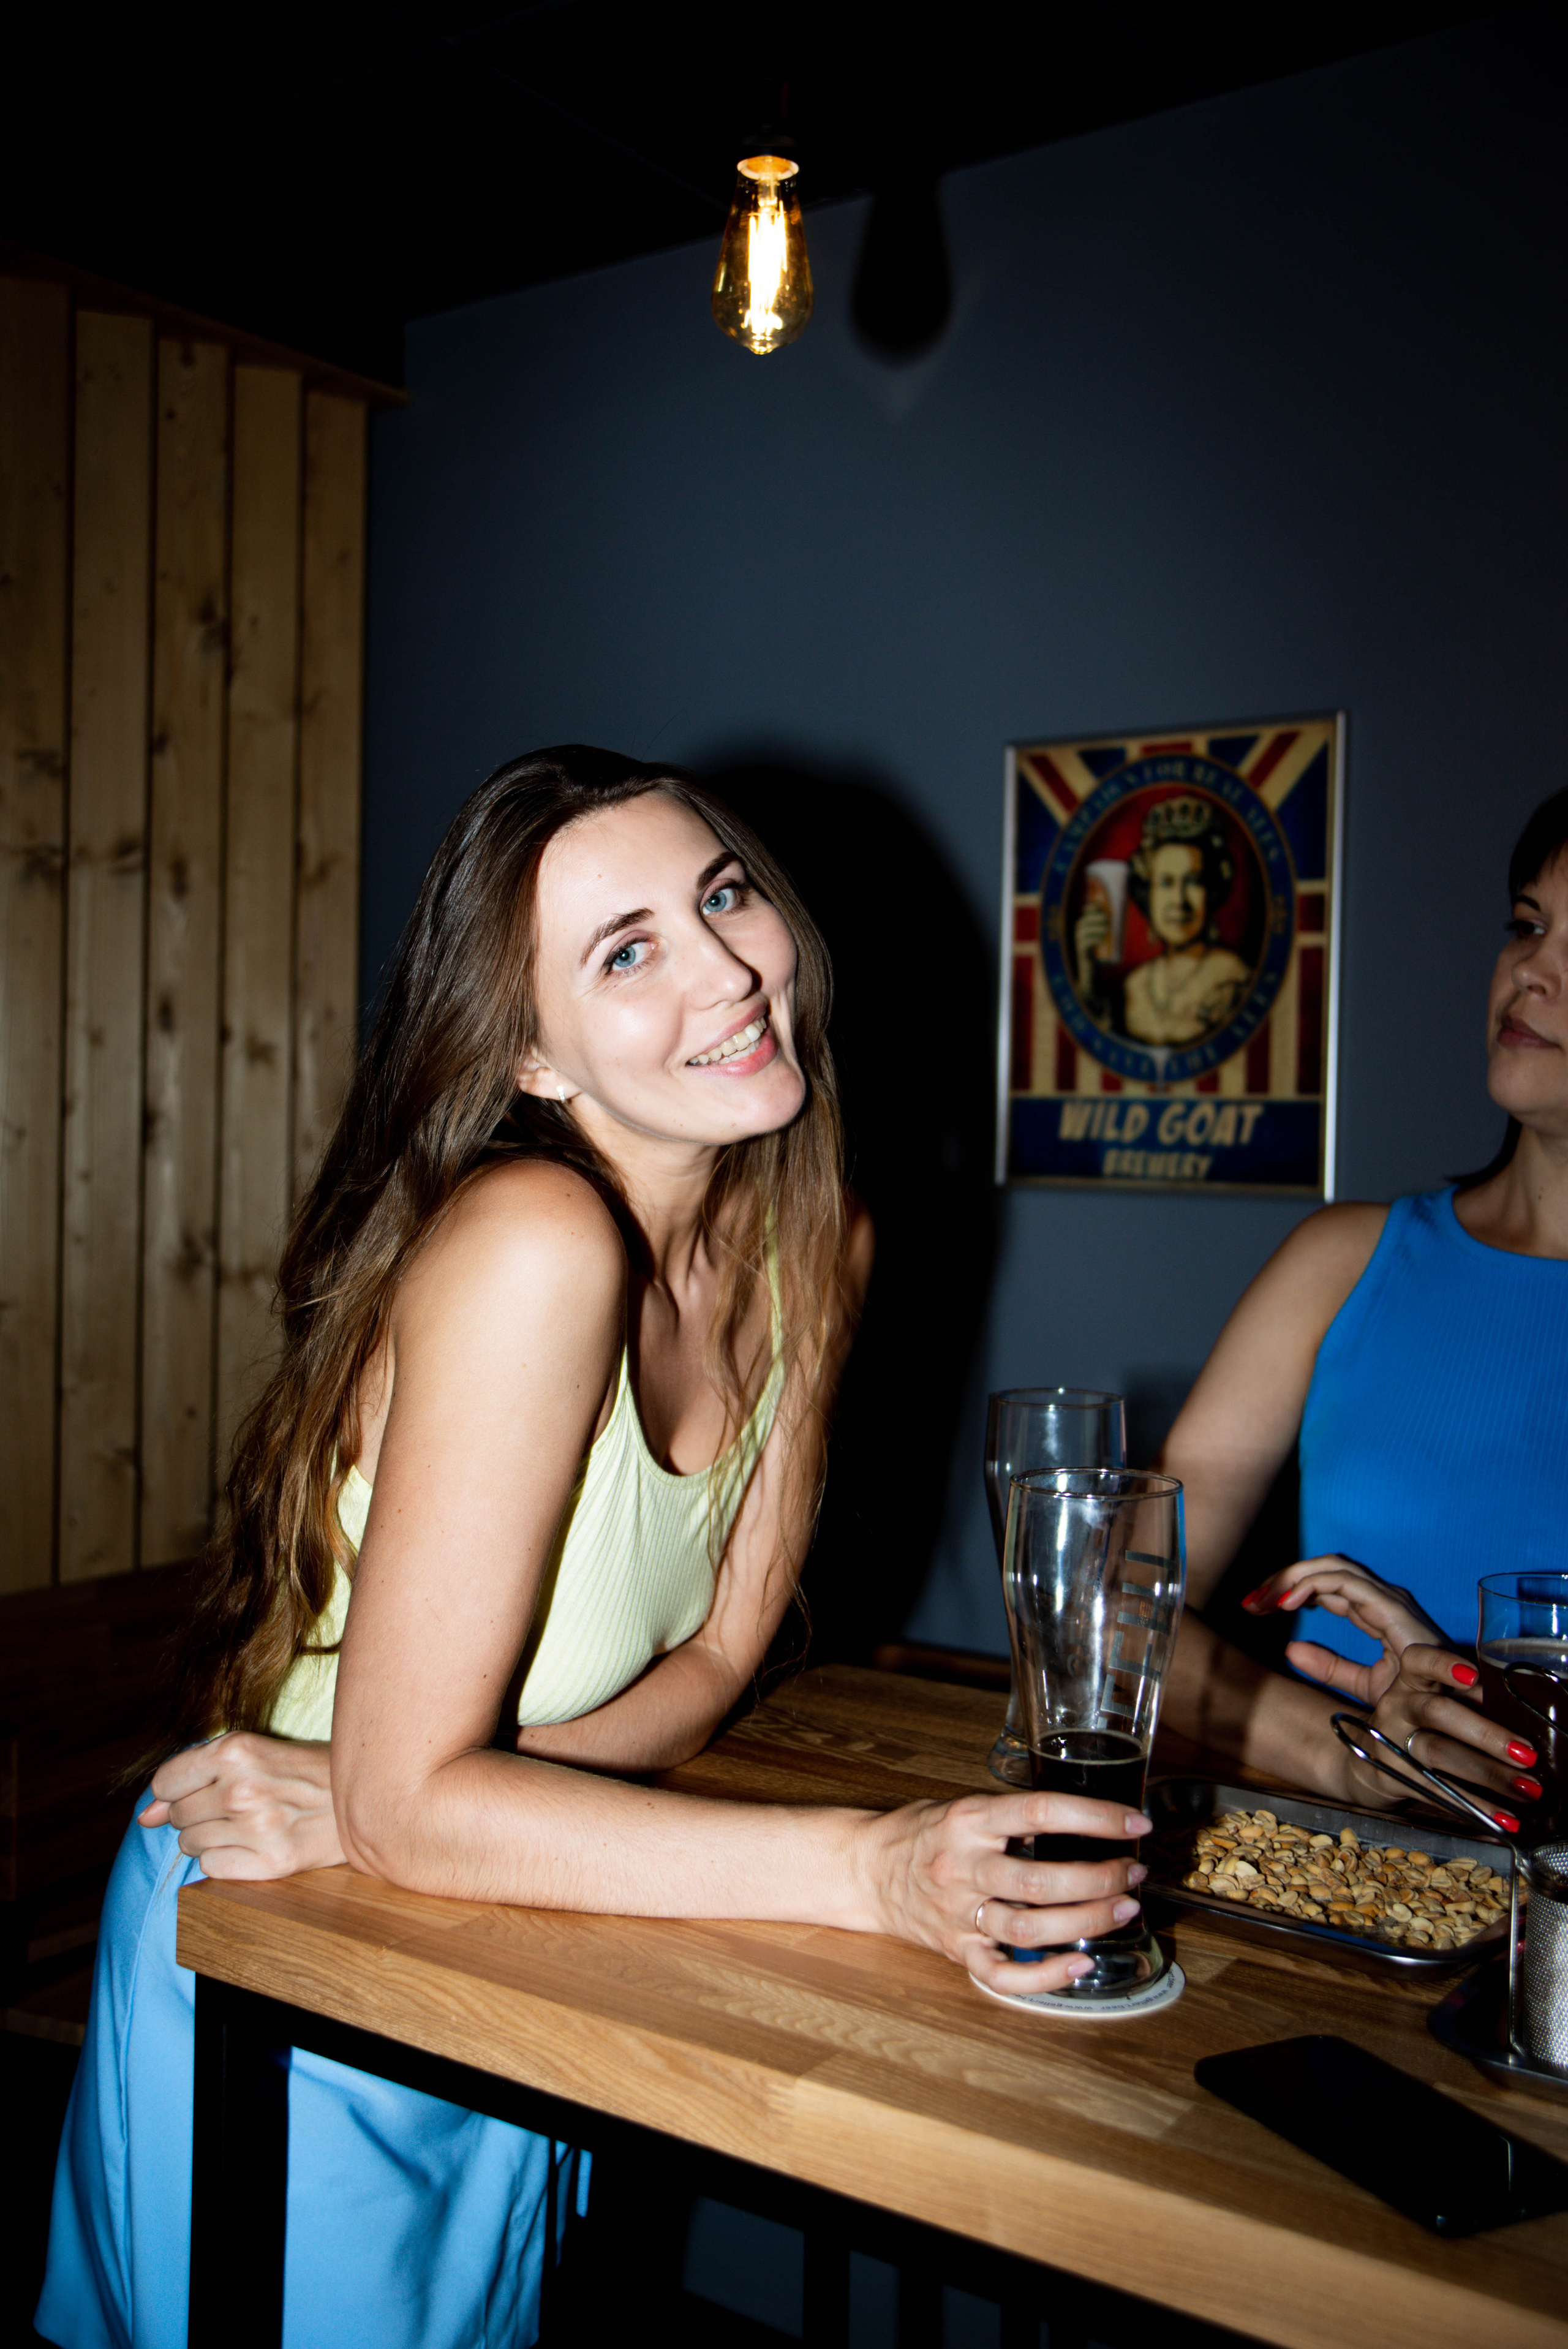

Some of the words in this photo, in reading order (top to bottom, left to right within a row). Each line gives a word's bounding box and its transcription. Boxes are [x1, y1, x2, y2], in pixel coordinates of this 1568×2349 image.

[1059, 1102, 1149, 1143] WILD
[1157, 1102, 1264, 1146] GOAT
[1103, 1148, 1212, 1178] BREWERY
[1014, 1993, 1092, 2009] www.gellert.be
